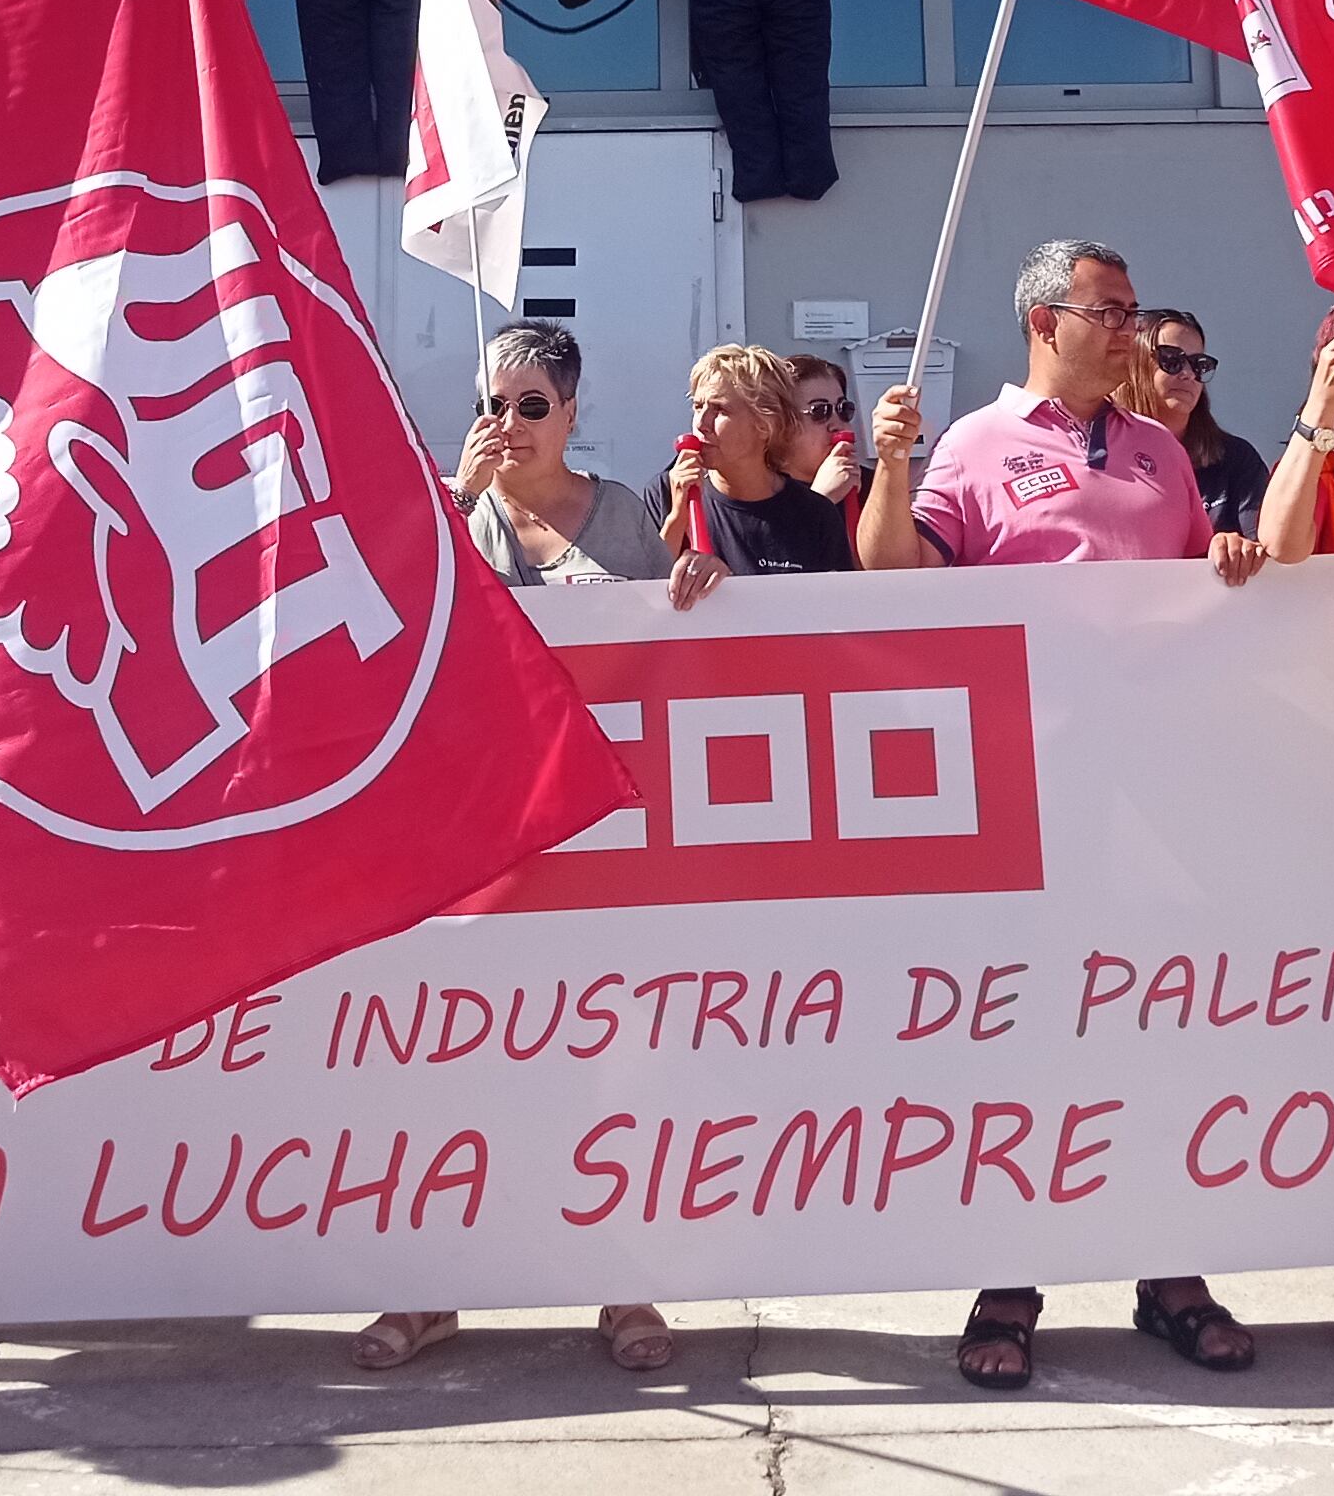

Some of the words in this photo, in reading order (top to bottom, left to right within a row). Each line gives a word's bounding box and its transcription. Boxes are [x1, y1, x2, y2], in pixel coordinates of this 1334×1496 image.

[1017, 471, 1062, 492] CCOO
[326, 968, 845, 1071] INDUSTRIA
[897, 962, 1030, 1042] DE
[81, 1128, 489, 1238] LUCHA
[561, 1096, 1126, 1227] SIEMPRE
